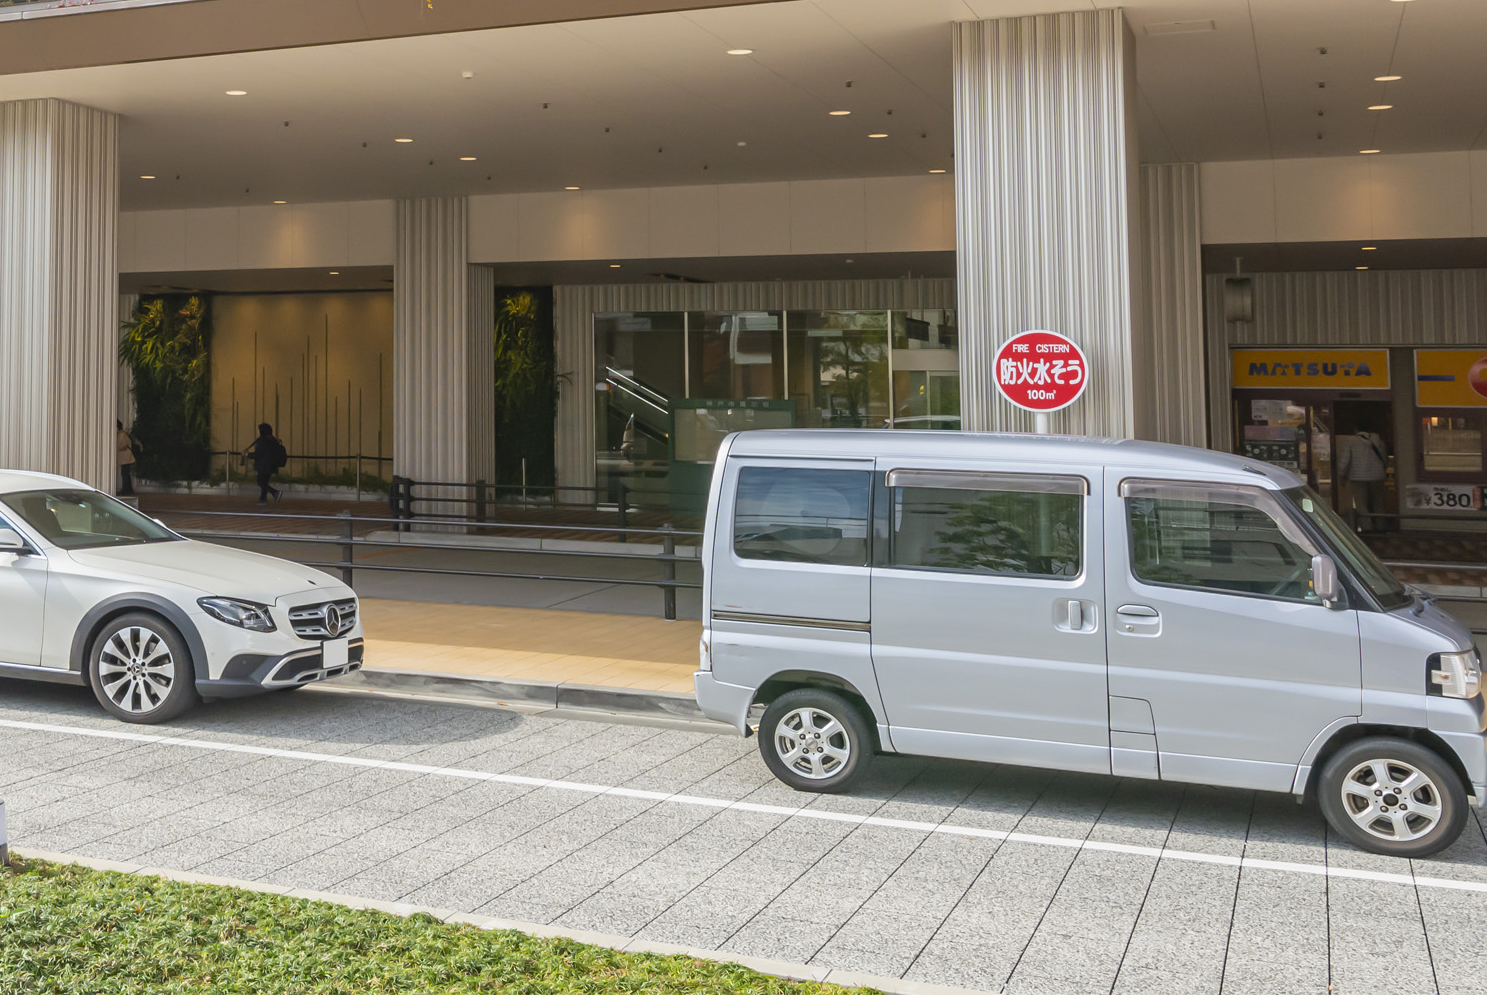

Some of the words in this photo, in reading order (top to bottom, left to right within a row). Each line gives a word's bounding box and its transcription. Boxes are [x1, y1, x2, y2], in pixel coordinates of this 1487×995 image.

[1012, 344, 1030, 353] FIRE
[1036, 344, 1070, 353] CISTERN
[1000, 358, 1082, 385] 防火水そう
